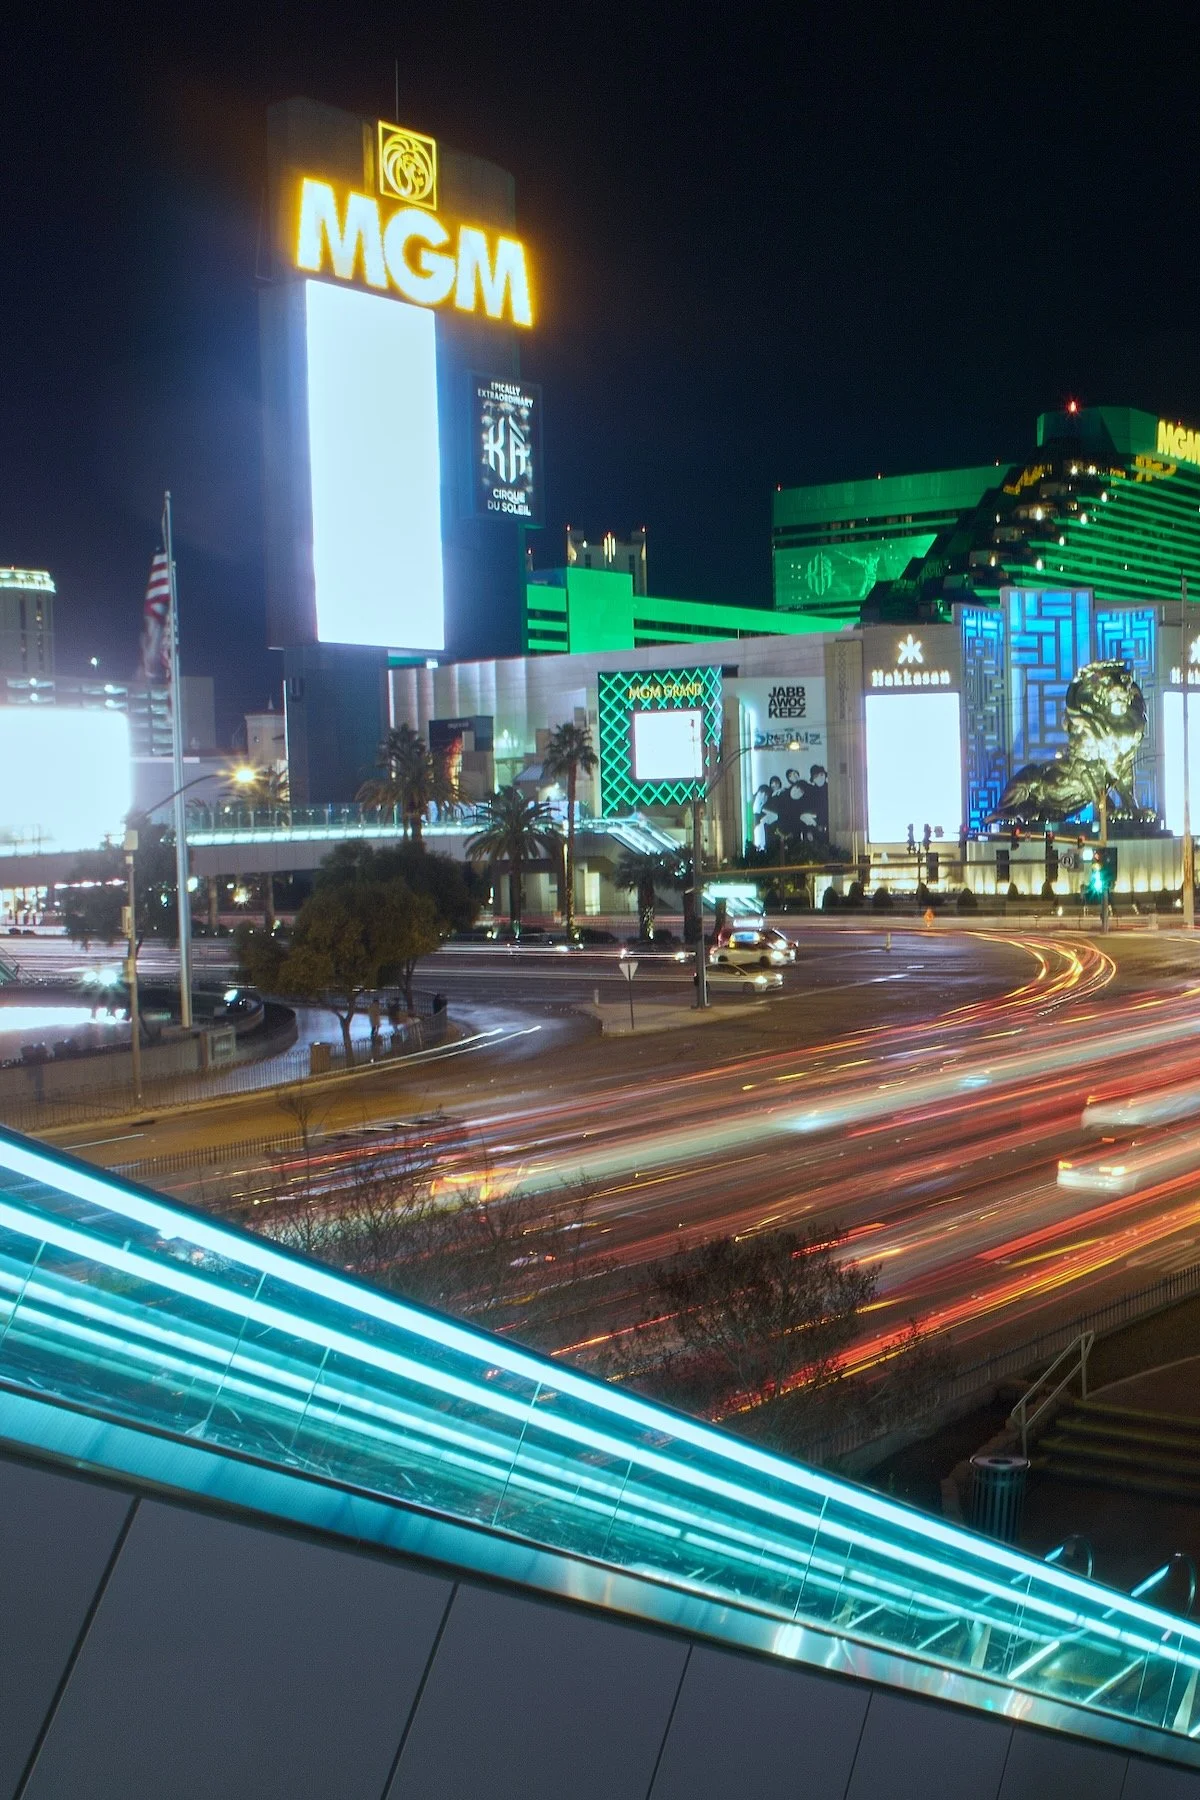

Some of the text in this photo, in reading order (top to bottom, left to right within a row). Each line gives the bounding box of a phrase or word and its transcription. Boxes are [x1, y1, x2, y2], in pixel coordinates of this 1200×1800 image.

[297, 176, 533, 328] MGM
[490, 381, 521, 396] EPICALLY
[477, 387, 534, 408] EXTRAORDINARY
[492, 488, 526, 505] CIRQUE
[487, 500, 532, 517] DU SOLEIL
[872, 668, 951, 687] Hakkasan
[628, 682, 704, 700] MGM GRAND
[768, 686, 806, 698] JABB
[768, 697, 806, 708] AWOC
[768, 707, 807, 719] KEEZ
